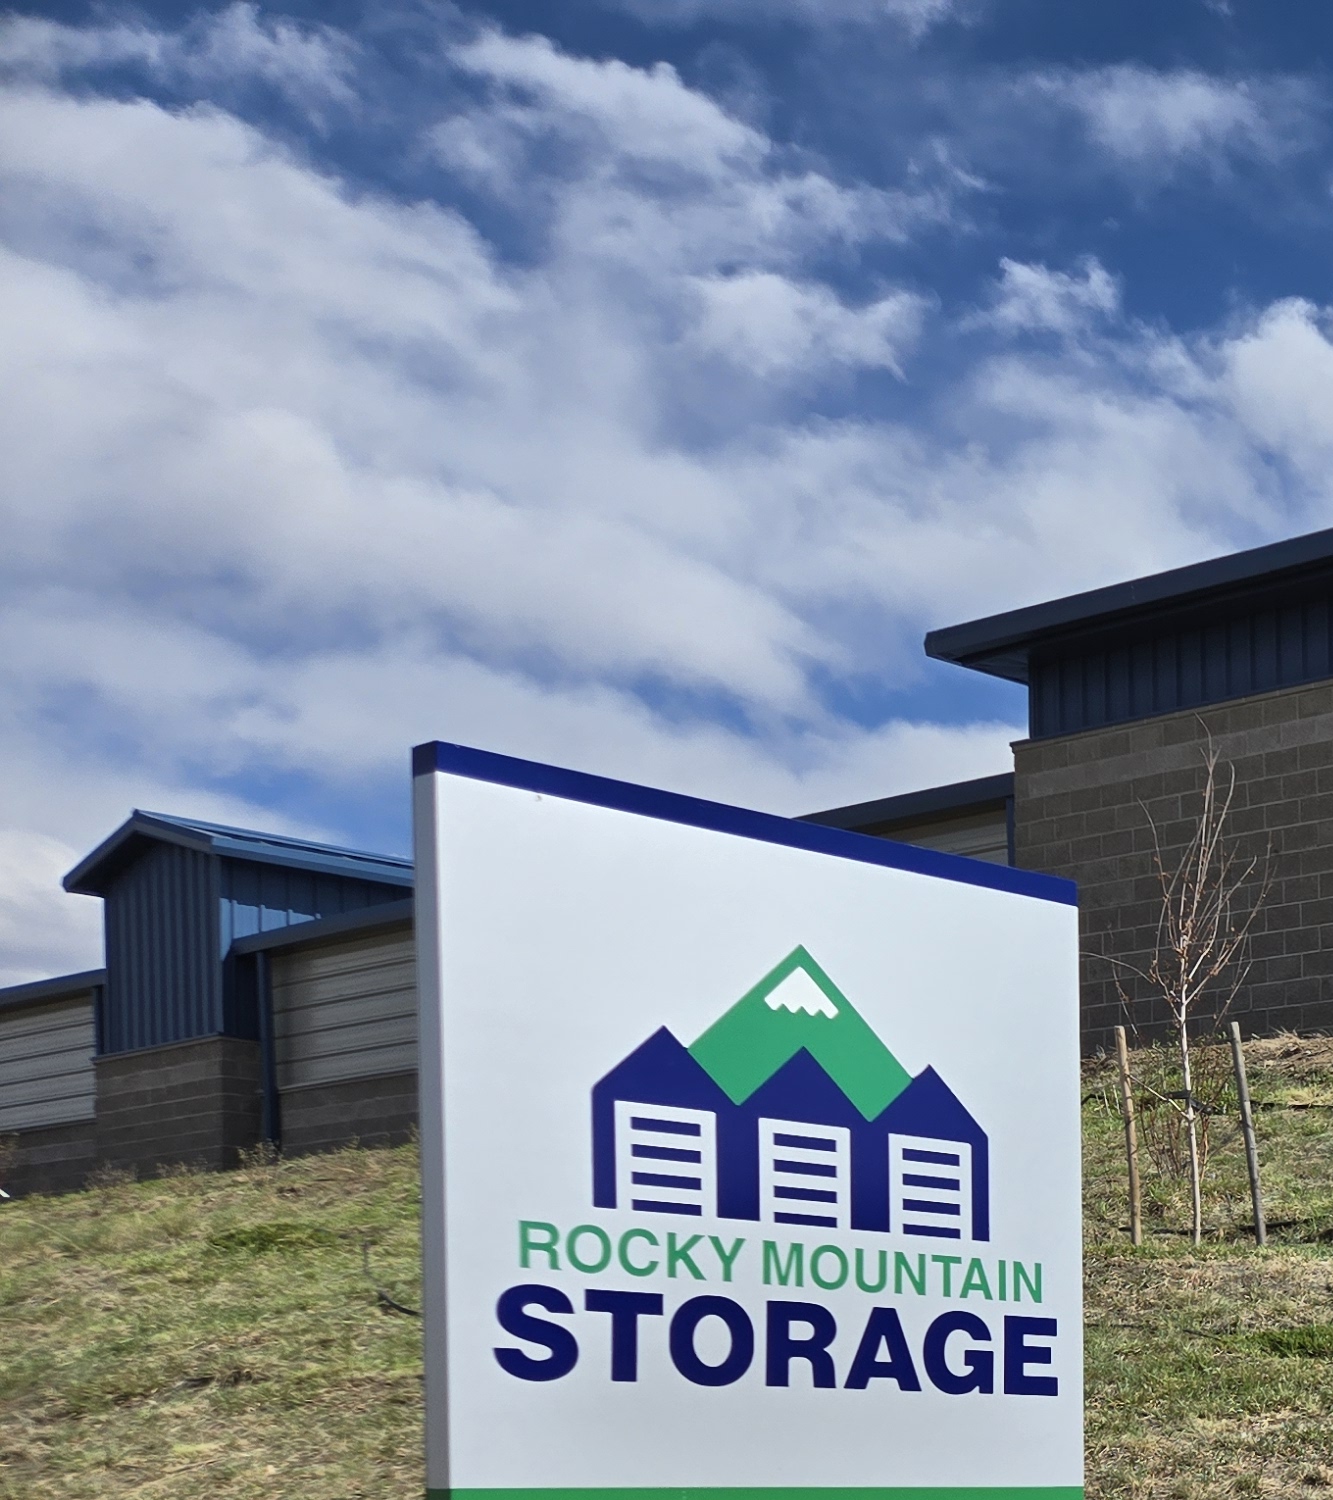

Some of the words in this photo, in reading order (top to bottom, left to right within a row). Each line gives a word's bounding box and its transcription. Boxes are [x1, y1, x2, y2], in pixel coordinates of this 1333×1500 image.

[518, 1220, 746, 1283] ROCKY
[762, 1239, 1043, 1303] MOUNTAIN
[493, 1284, 1059, 1396] STORAGE
